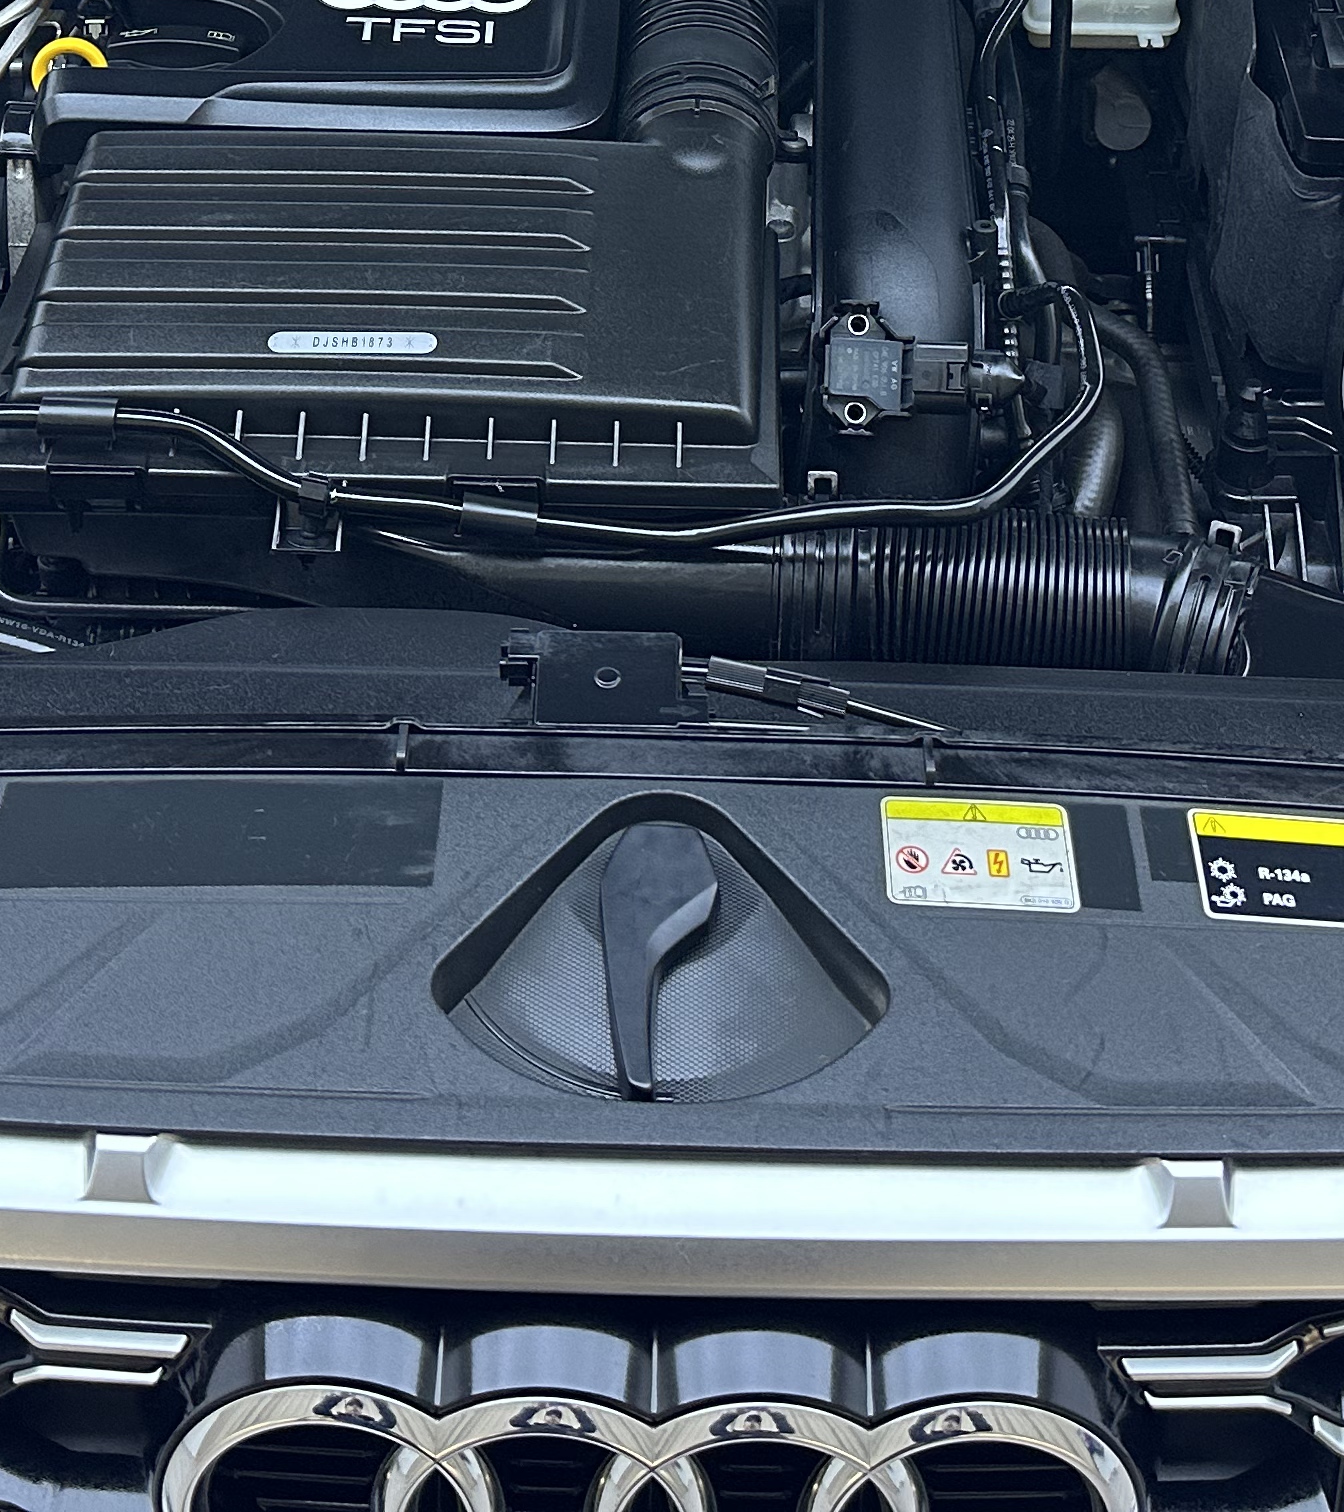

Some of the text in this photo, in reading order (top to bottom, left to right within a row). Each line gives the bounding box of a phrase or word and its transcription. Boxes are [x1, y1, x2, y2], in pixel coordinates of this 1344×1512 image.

[346, 17, 494, 45] TFSI
[1257, 866, 1312, 884] R-134a
[1262, 892, 1296, 908] PAG
